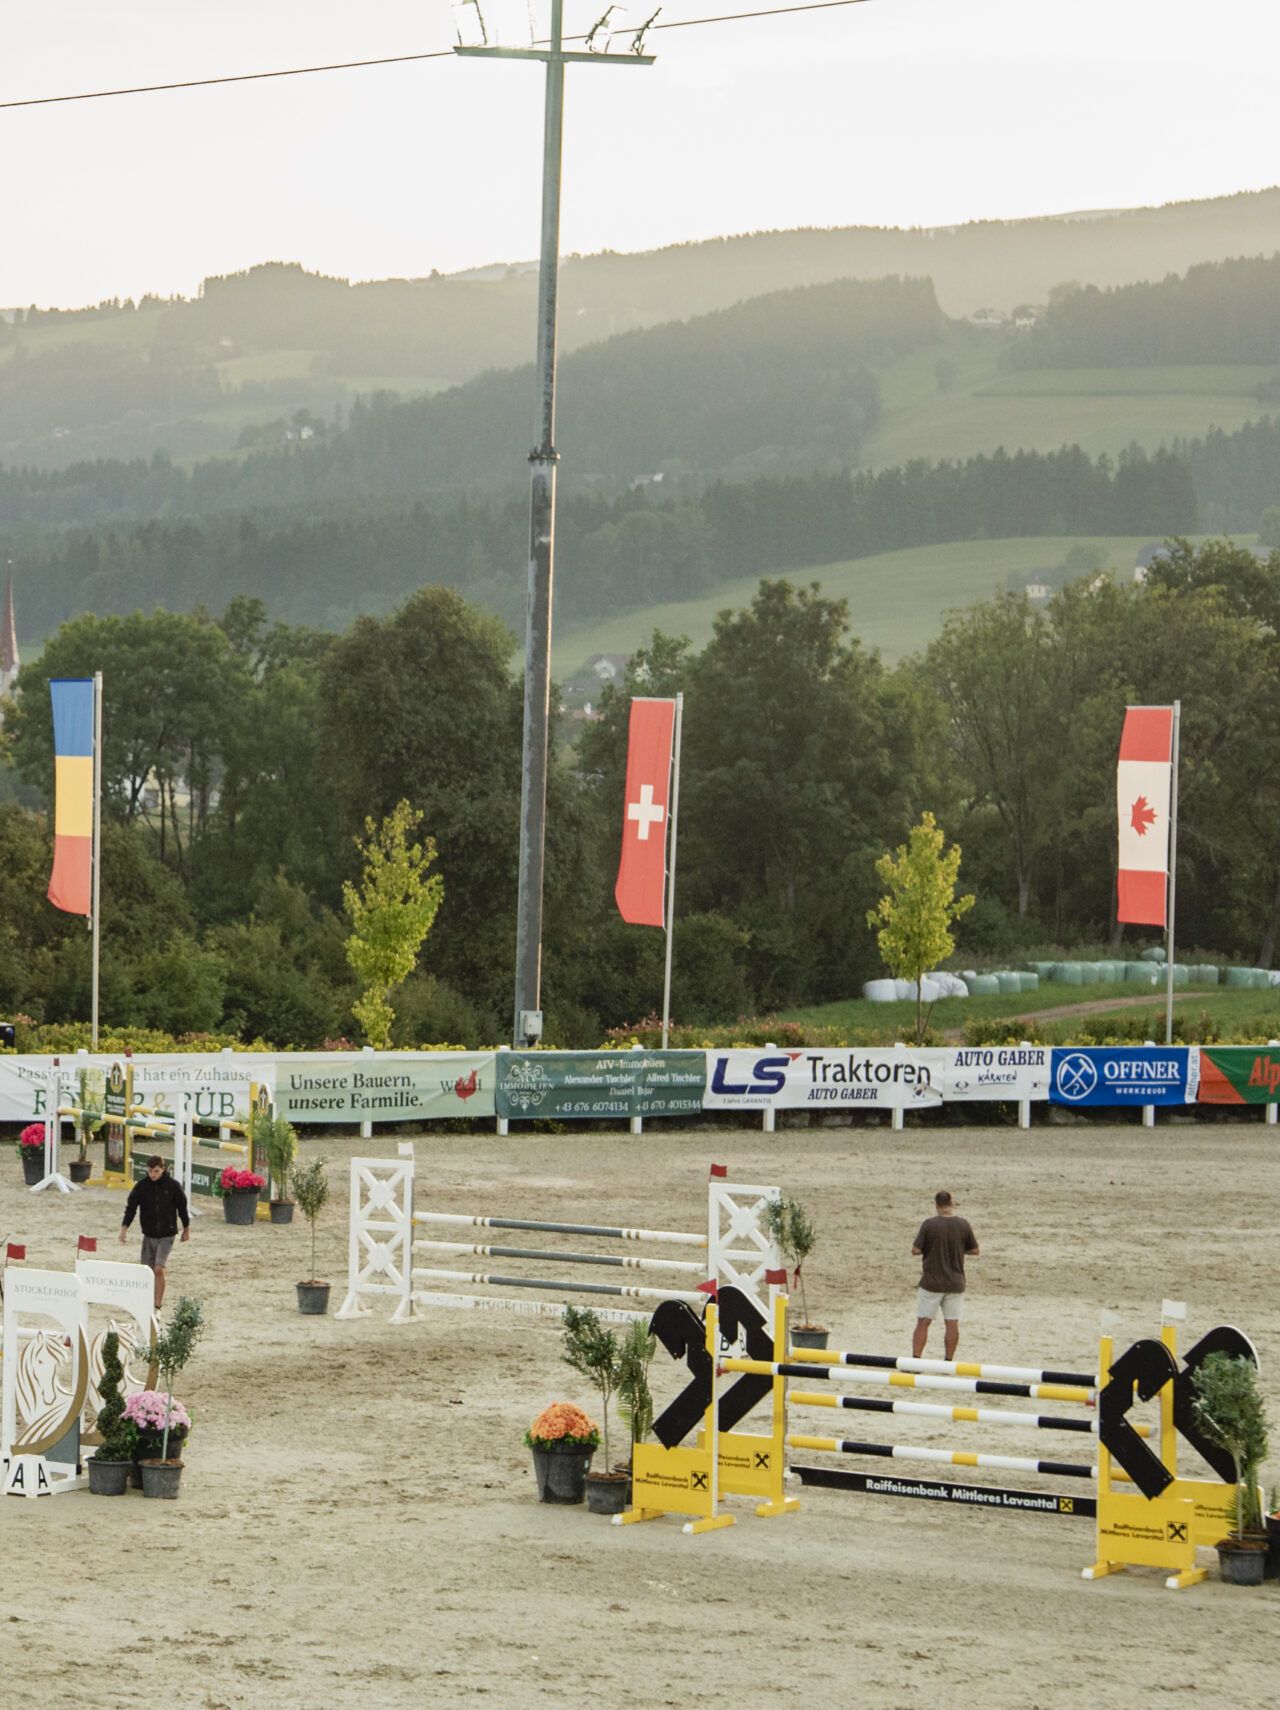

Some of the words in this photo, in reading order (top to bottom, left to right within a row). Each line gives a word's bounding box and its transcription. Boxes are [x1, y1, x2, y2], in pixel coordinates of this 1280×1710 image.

[955, 1051, 993, 1066] AUTO
[998, 1050, 1045, 1066] GABER
[144, 1067, 166, 1081] hat
[170, 1067, 190, 1081] ein
[195, 1066, 251, 1081] Zuhause
[711, 1056, 790, 1094] LS
[807, 1055, 931, 1087] Traktoren
[1104, 1061, 1180, 1079] OFFNER
[290, 1073, 348, 1090] Unsere
[353, 1072, 416, 1089] Bauern,
[808, 1088, 838, 1100] AUTO
[840, 1088, 878, 1100] GABER
[1116, 1087, 1166, 1095] WERKZEUGE
[289, 1096, 345, 1110] unsere
[350, 1091, 423, 1109] Farmilie.
[11, 1462, 24, 1489] A
[38, 1462, 48, 1489] A
[866, 1479, 949, 1498] Raiffeisenbank
[952, 1488, 1001, 1505] Mittleres
[1003, 1494, 1058, 1510] Lavanttal
